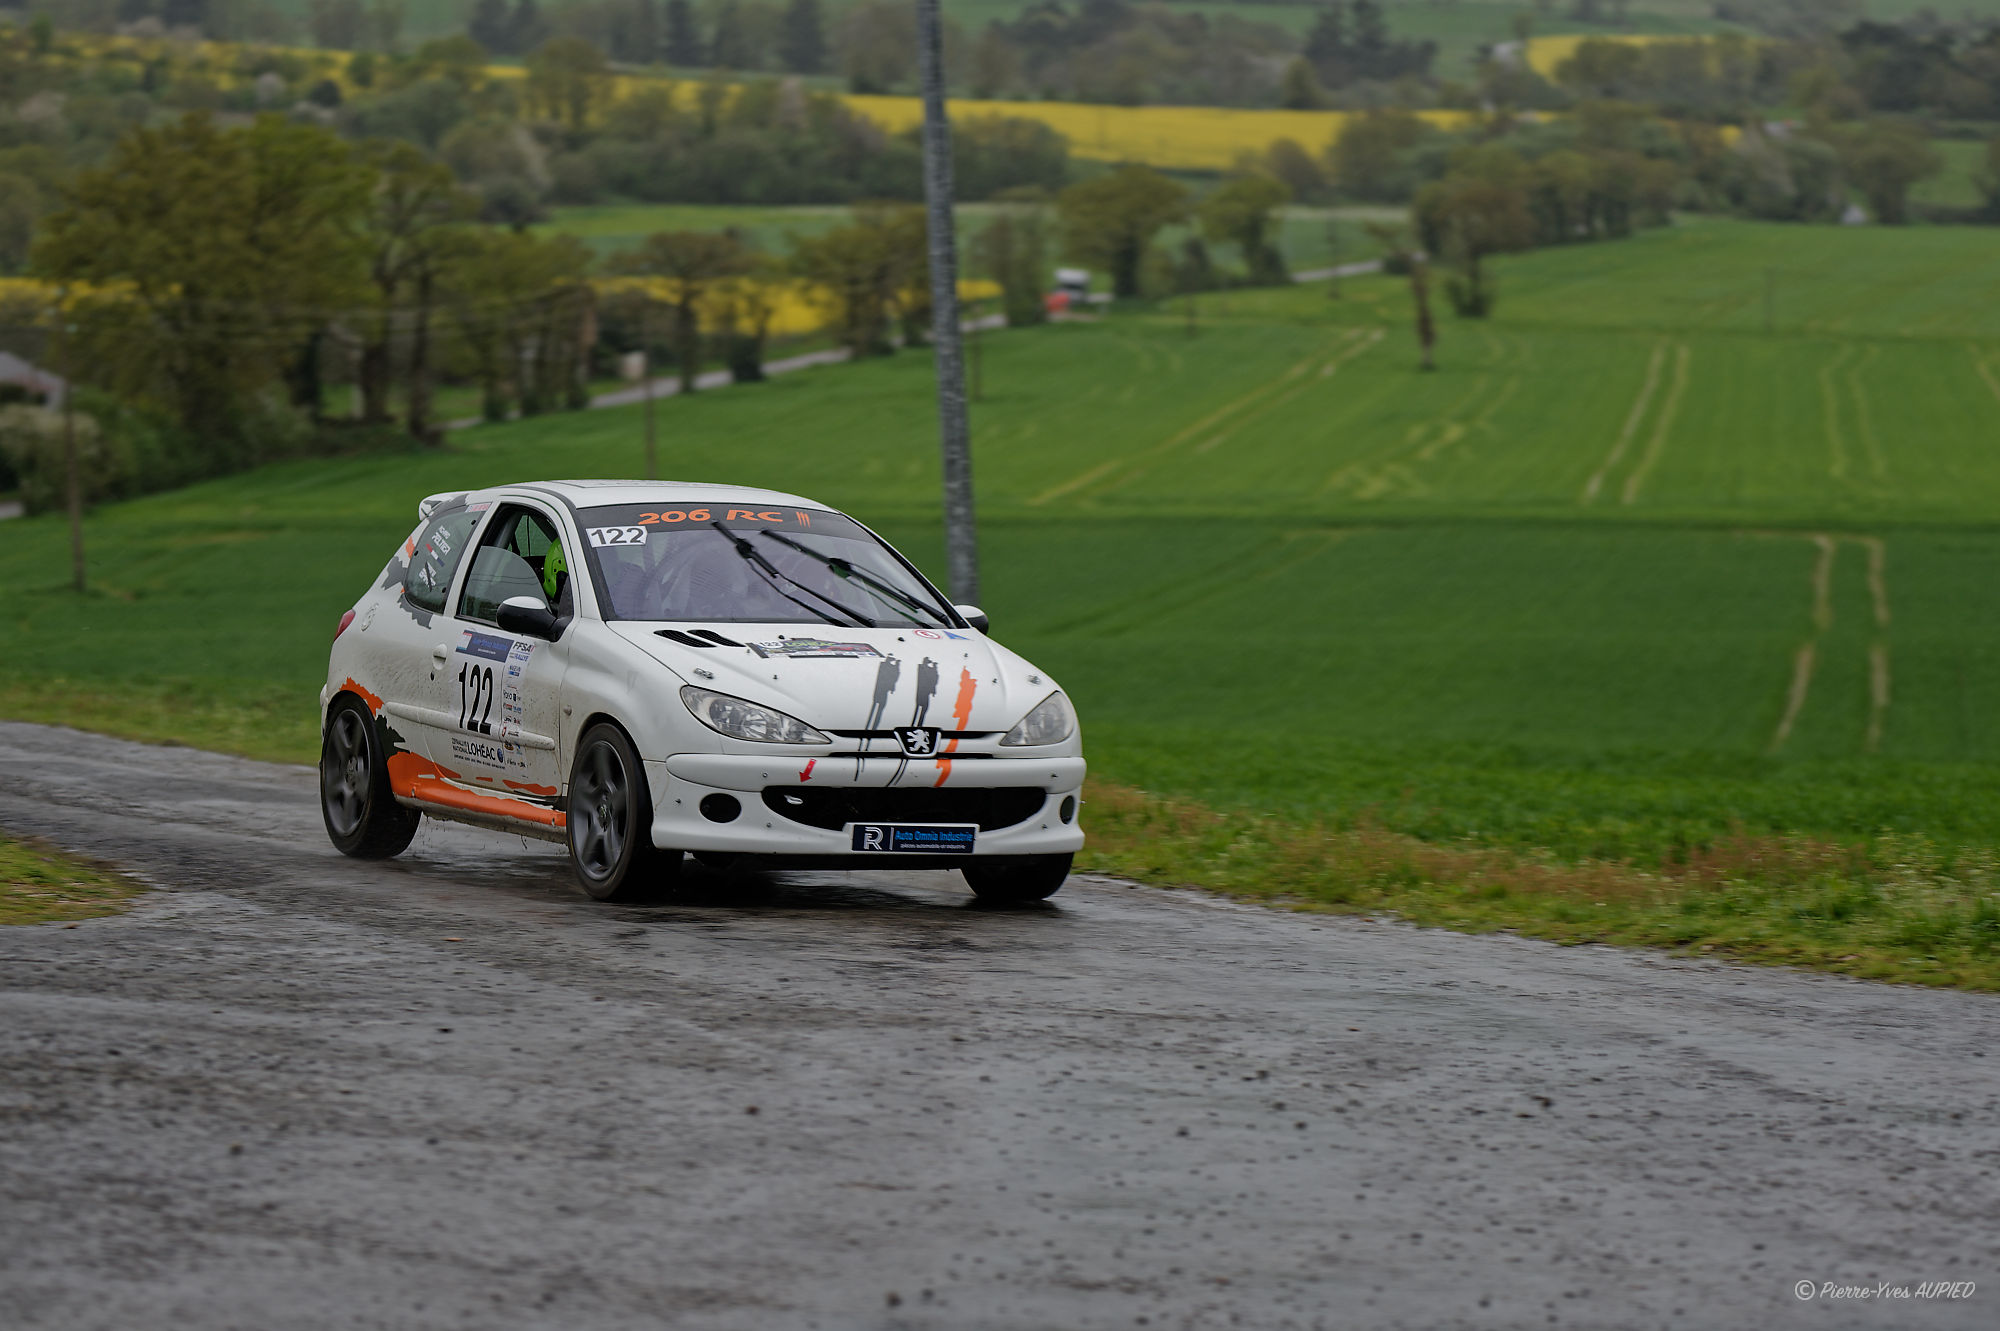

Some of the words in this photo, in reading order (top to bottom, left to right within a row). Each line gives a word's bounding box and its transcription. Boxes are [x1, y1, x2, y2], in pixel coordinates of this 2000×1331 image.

[637, 508, 711, 525] 206
[726, 509, 783, 522] RC
[590, 527, 644, 545] 122
[512, 641, 531, 653] FFSA
[458, 661, 493, 735] 122
[467, 742, 496, 760] LOHÉAC
[895, 830, 913, 840] Auto
